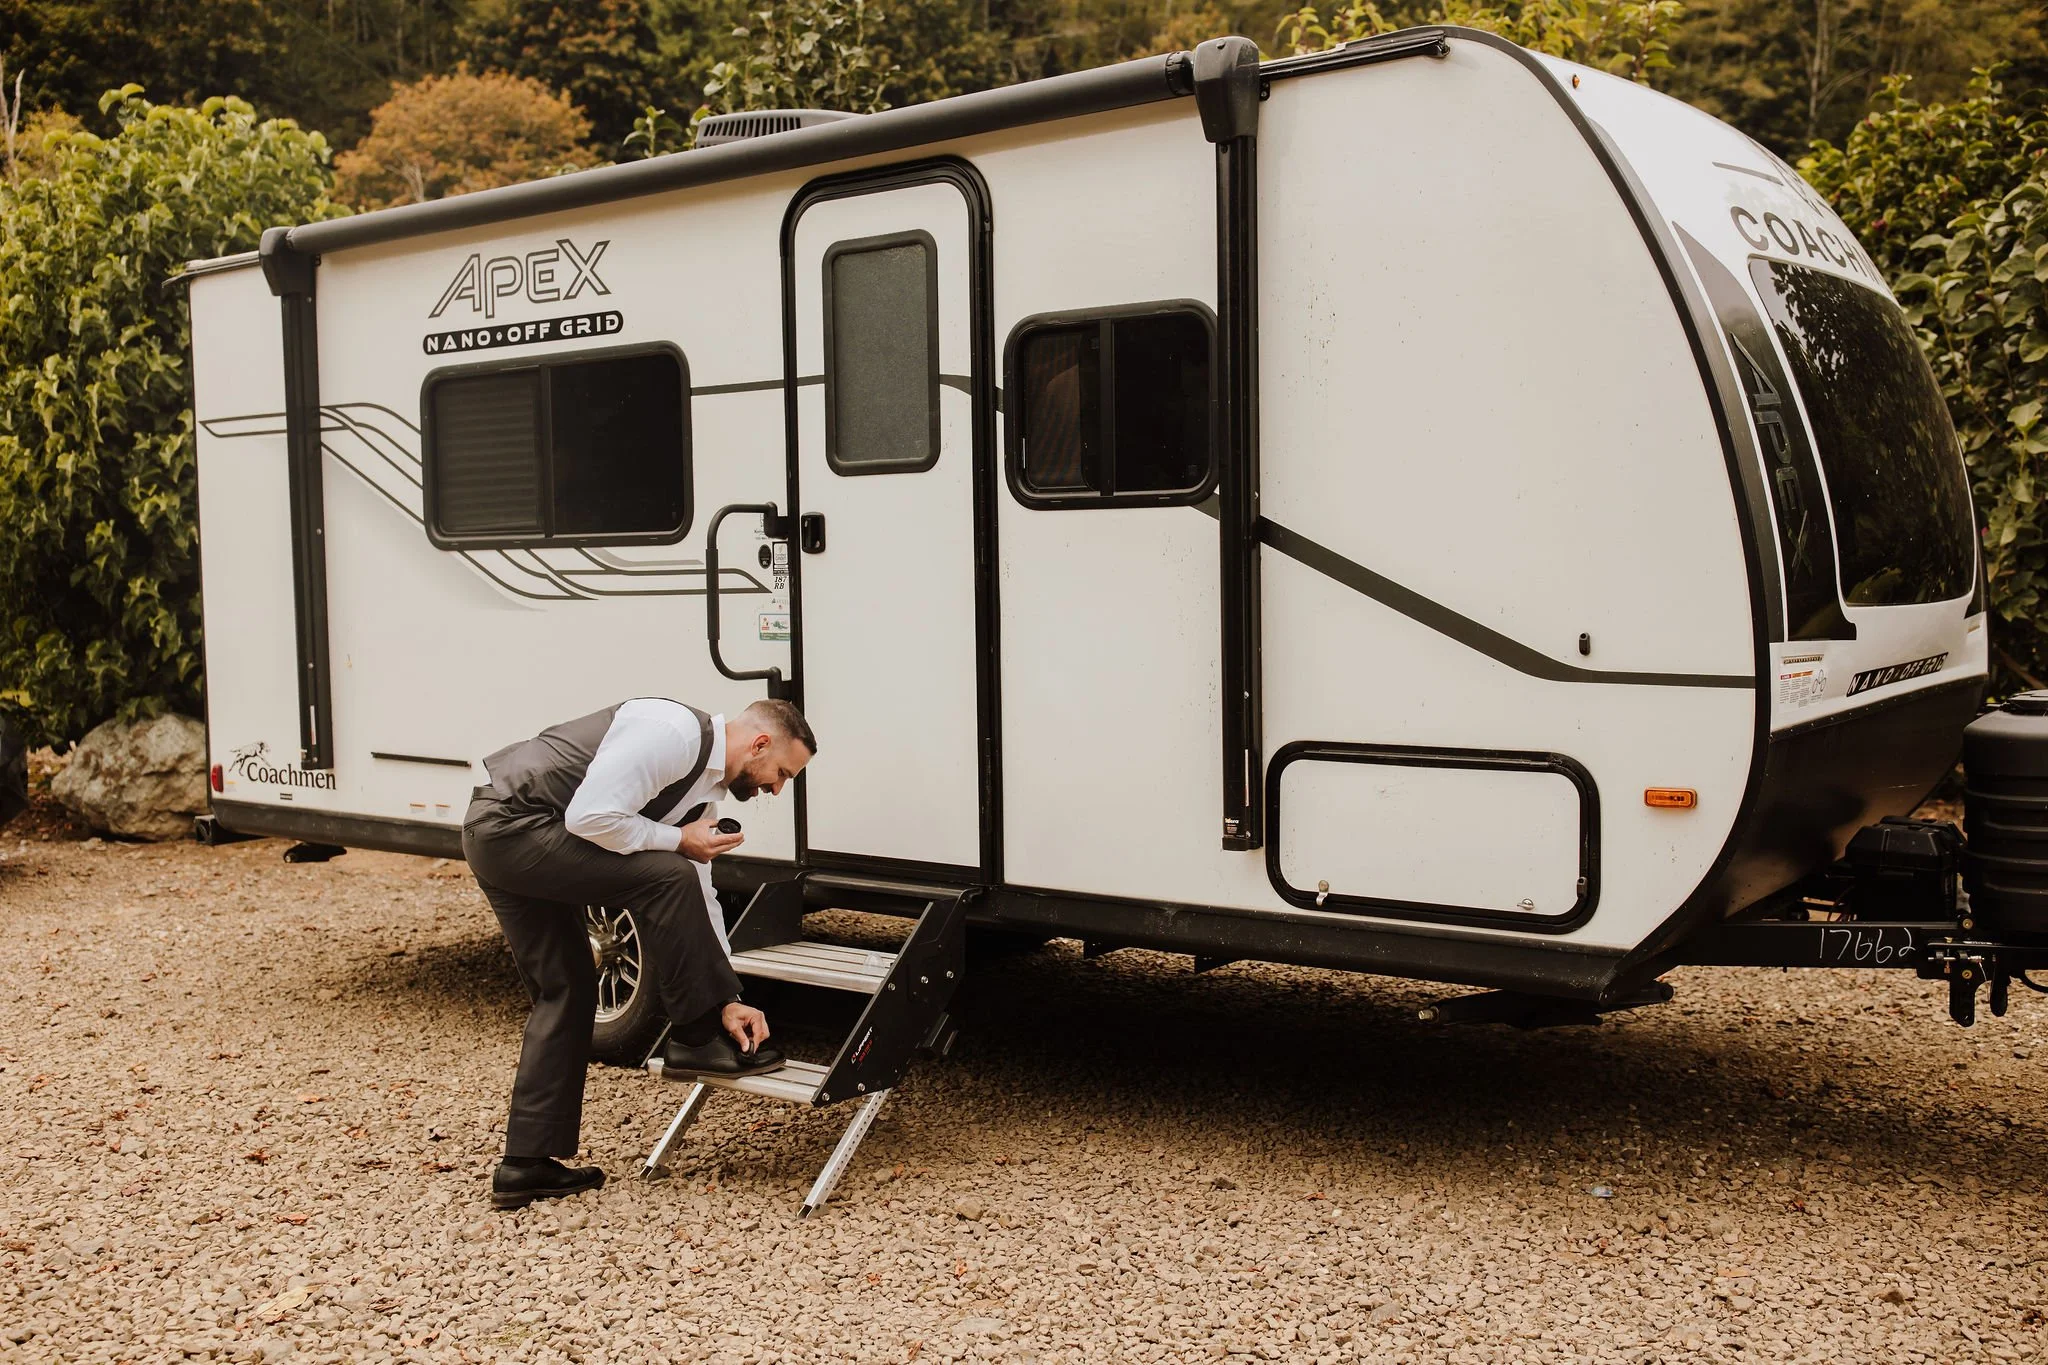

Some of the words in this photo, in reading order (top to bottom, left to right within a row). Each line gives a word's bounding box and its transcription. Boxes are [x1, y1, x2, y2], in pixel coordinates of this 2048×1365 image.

[428, 239, 612, 319] APEX
[426, 334, 491, 352] NANO
[507, 322, 551, 342] OFF
[560, 314, 619, 335] GRID
[1730, 331, 1813, 583] APEX
[1847, 667, 1895, 695] NANO
[1900, 661, 1924, 680] OFF
[246, 762, 337, 790] Coachmen
[1819, 927, 1917, 964] 17662
